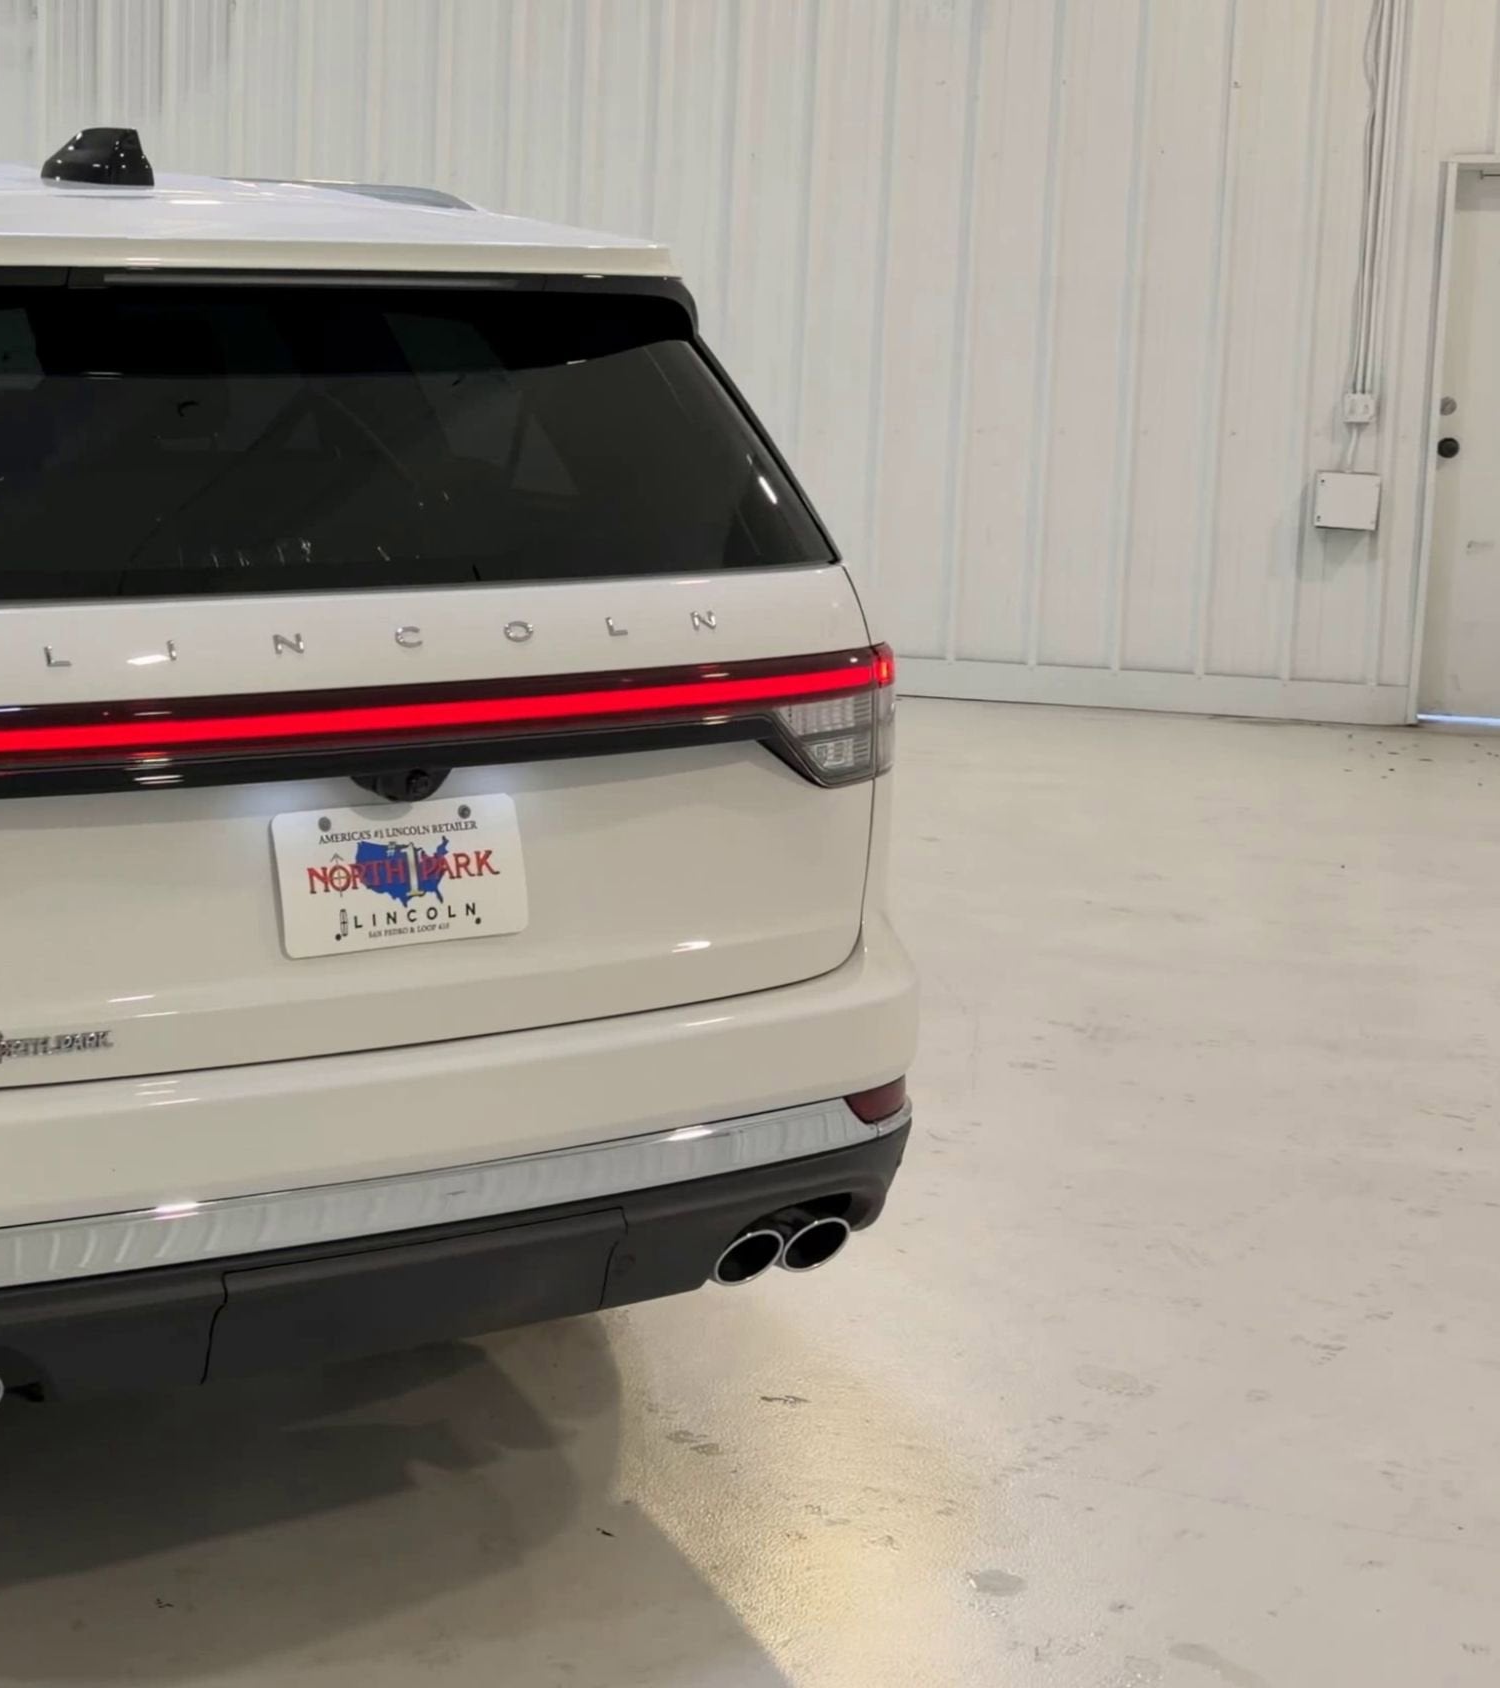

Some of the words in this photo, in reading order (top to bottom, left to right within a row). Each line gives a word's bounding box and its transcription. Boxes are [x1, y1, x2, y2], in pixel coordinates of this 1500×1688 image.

[43, 609, 718, 668] LINCOLN
[318, 829, 372, 845] AMERICA'S
[385, 824, 431, 838] LINCOLN
[432, 820, 478, 834] RETAILER
[306, 857, 406, 894] NORTH
[419, 850, 500, 881] PARK
[353, 902, 476, 929] LINCOLN
[55, 1030, 114, 1052] PARK
